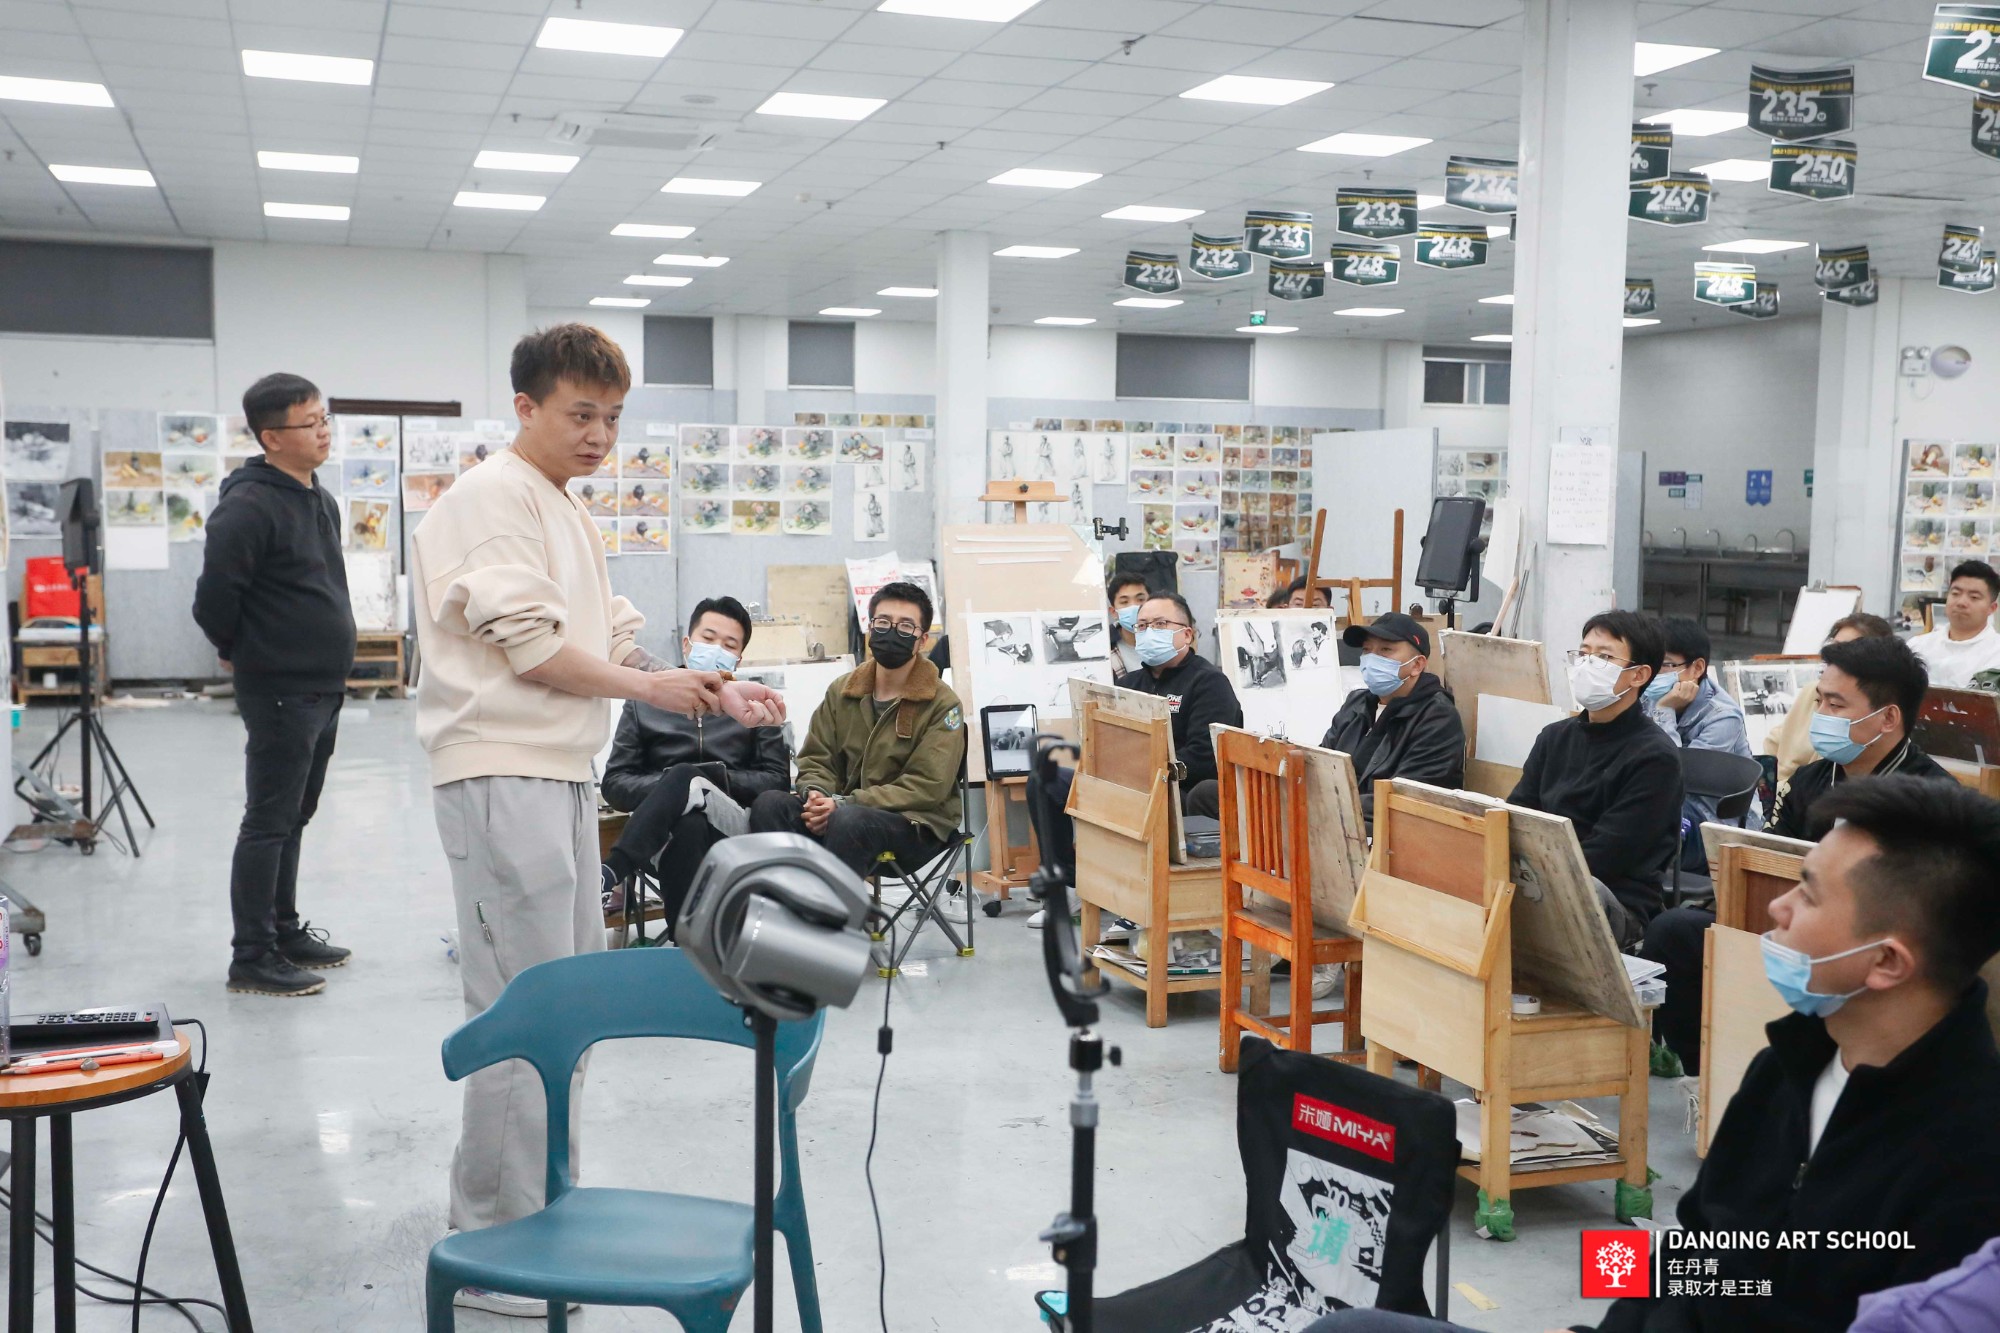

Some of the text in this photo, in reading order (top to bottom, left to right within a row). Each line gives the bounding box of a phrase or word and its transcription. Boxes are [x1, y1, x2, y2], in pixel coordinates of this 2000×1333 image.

[1760, 88, 1821, 123] 235
[1790, 154, 1847, 183] 250
[1646, 185, 1697, 212] 249
[1353, 201, 1401, 226] 233
[1259, 224, 1303, 249] 233
[1429, 236, 1473, 259] 248
[1196, 247, 1235, 267] 232
[1344, 254, 1385, 277] 248
[1136, 263, 1175, 285] 232
[1273, 271, 1312, 294] 247
[1333, 1116, 1388, 1151] MIYA
